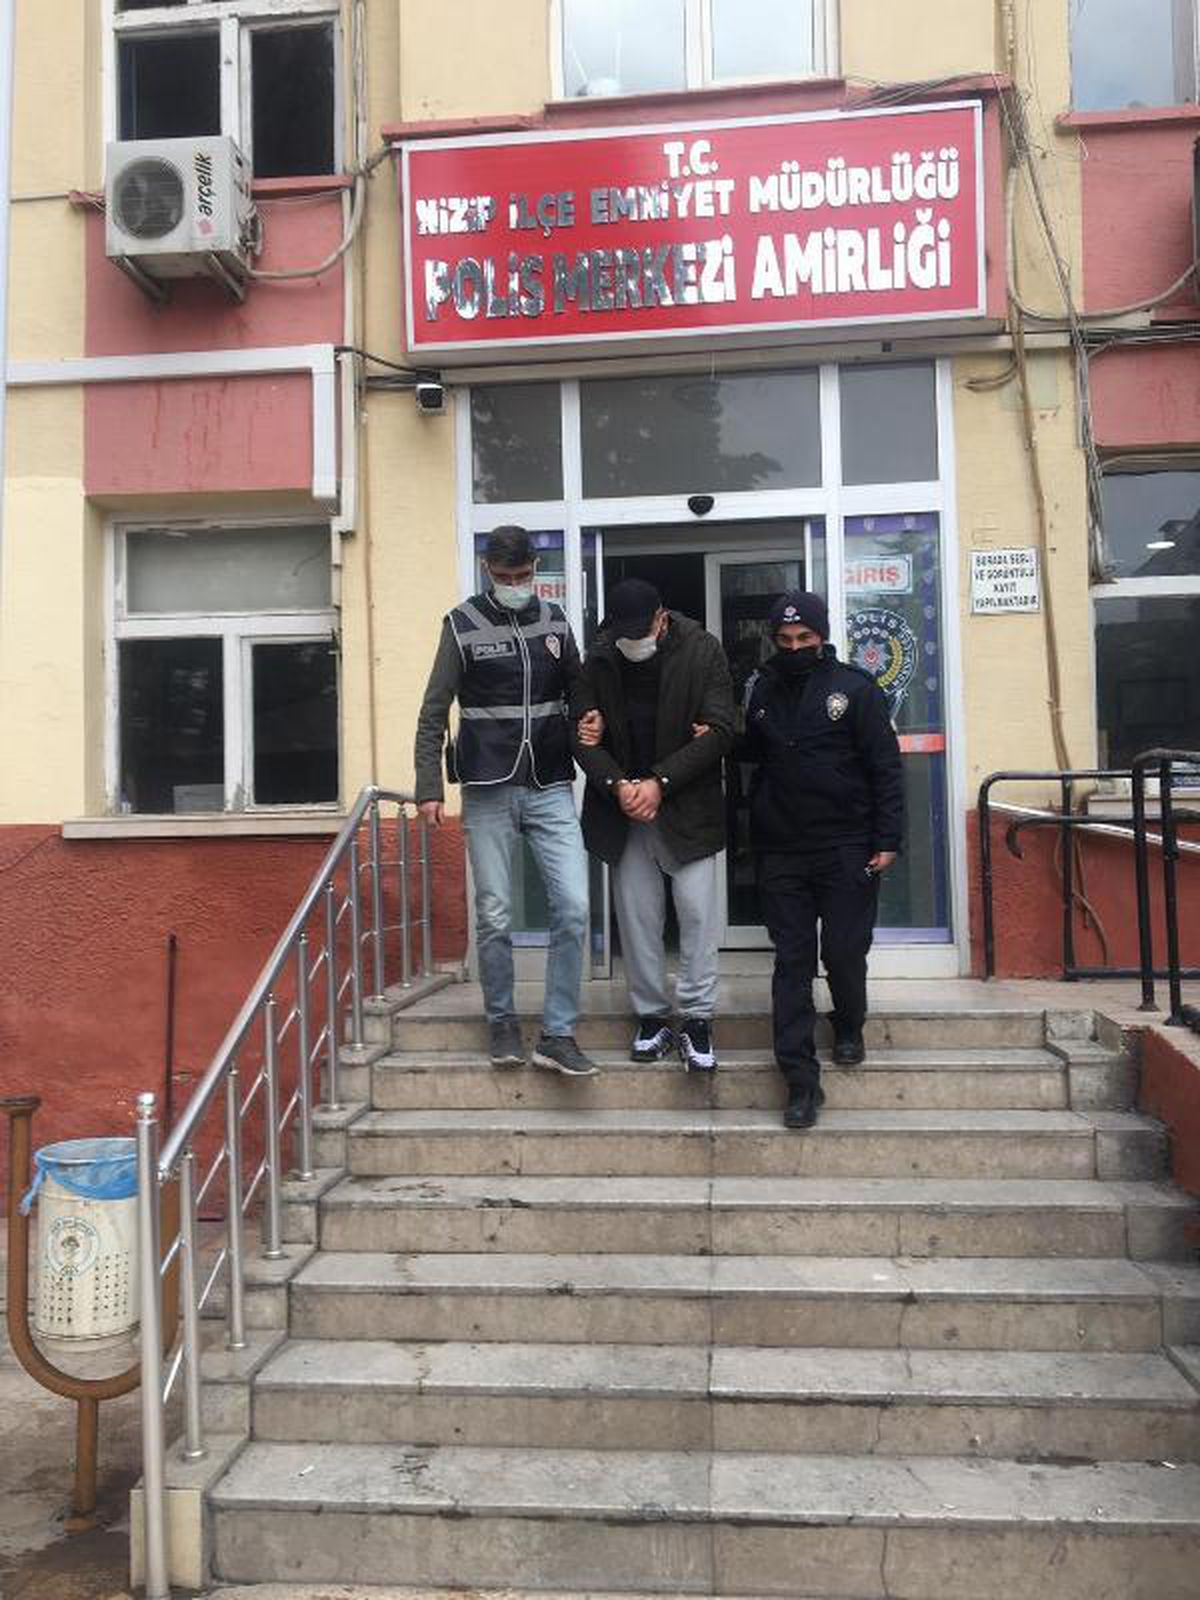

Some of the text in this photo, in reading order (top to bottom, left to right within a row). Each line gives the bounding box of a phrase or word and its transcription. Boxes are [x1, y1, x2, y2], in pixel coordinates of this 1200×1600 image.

[194, 152, 216, 217] arçelik
[509, 191, 576, 238] İLÇE
[591, 179, 736, 224] EMNİYET
[749, 146, 959, 213] MÜDÜRLÜĞÜ
[663, 139, 719, 178] T.C.
[424, 207, 951, 321] POLİS MERKEZİ AMİRLİĞİ
